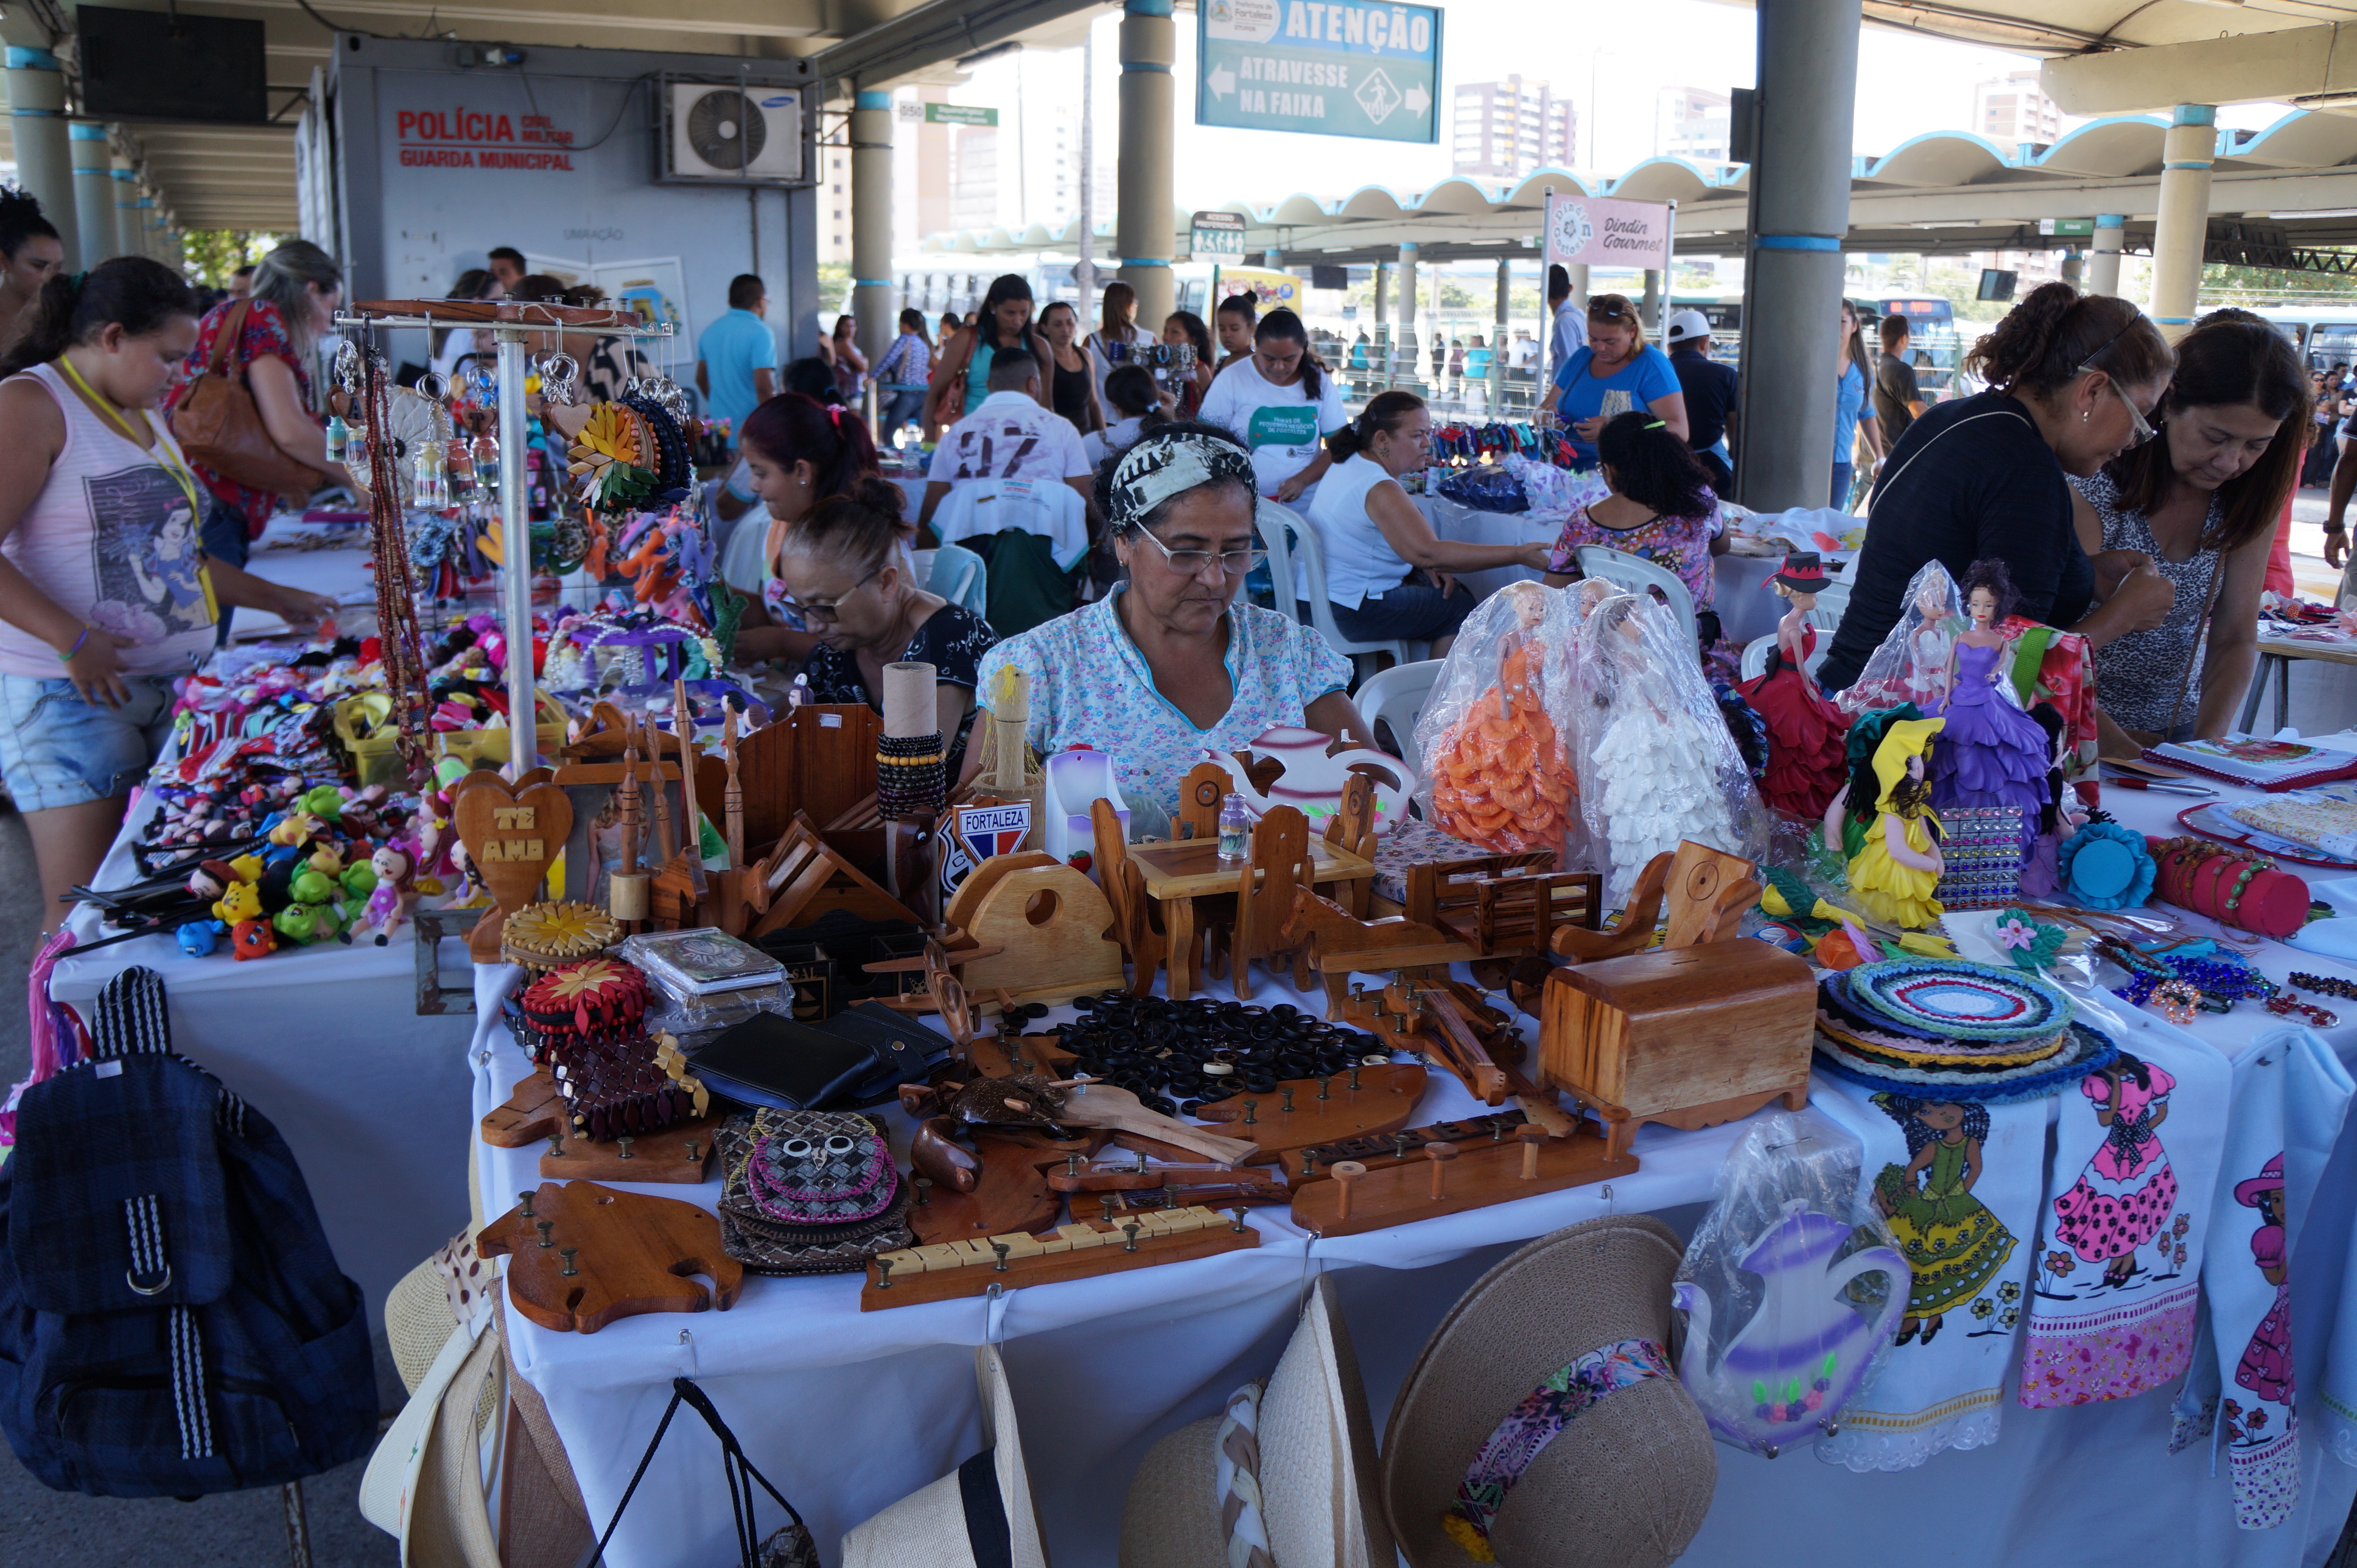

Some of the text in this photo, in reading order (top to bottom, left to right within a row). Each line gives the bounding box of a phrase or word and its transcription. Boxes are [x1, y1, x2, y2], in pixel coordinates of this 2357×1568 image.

[1235, 8, 1273, 20] Fortaleza
[1286, 1, 1431, 54] ATENÇÃO
[1239, 56, 1348, 88] ATRAVESSE
[1239, 89, 1326, 118] NA FAIXA
[398, 107, 516, 142] POLÍCIA
[521, 130, 573, 144] MILITAR
[400, 150, 575, 171] GUARDA MUNICIPAL
[1194, 219, 1245, 231] PREFERENCIAL
[1207, 213, 1235, 222] ACESSO
[1604, 217, 1648, 235] Dindin
[1603, 234, 1663, 252] Gourmet
[493, 806, 535, 830] TE
[966, 810, 1024, 831] FORTALEZA
[482, 839, 544, 863] AMO
[792, 967, 818, 979] SAL
[1305, 1129, 1429, 1166] DEUS
